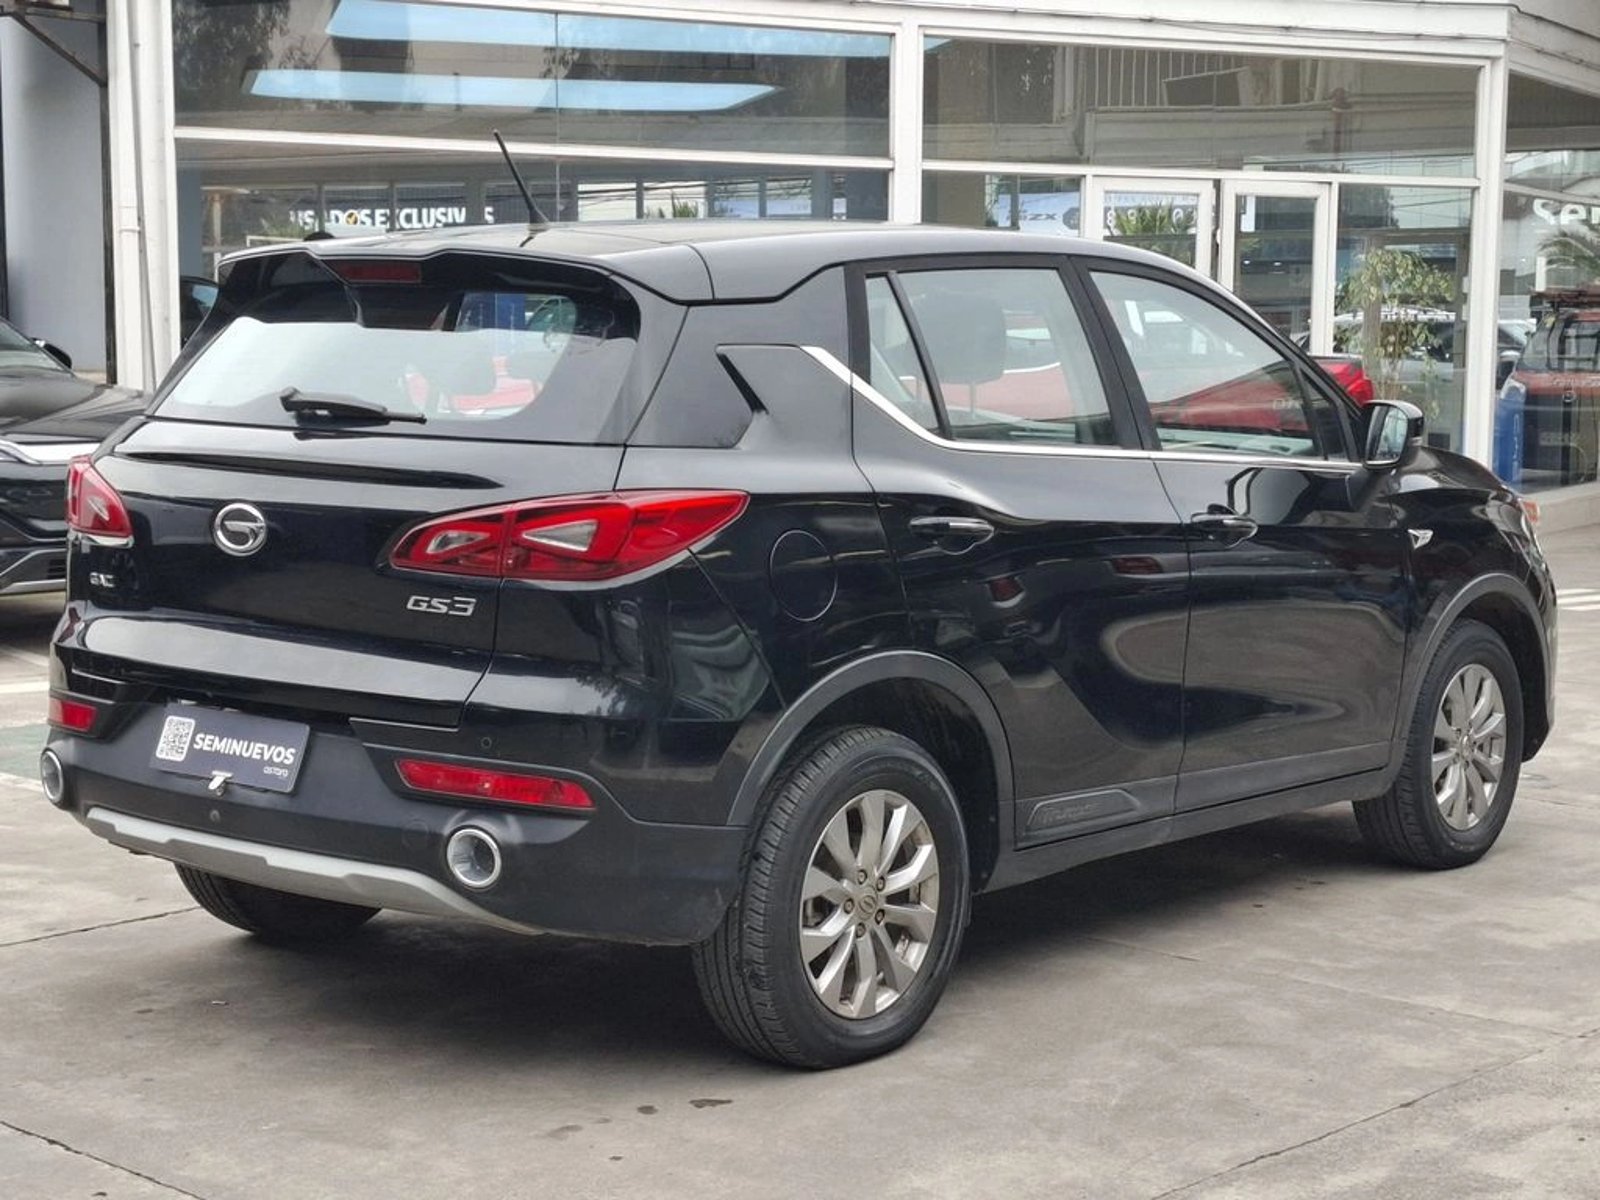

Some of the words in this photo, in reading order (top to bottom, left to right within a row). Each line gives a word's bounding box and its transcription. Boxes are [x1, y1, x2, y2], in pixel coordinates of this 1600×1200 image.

[374, 206, 494, 229] EXCLUSIVS
[406, 595, 476, 616] GS3
[193, 733, 296, 765] SEMINUEVOS
